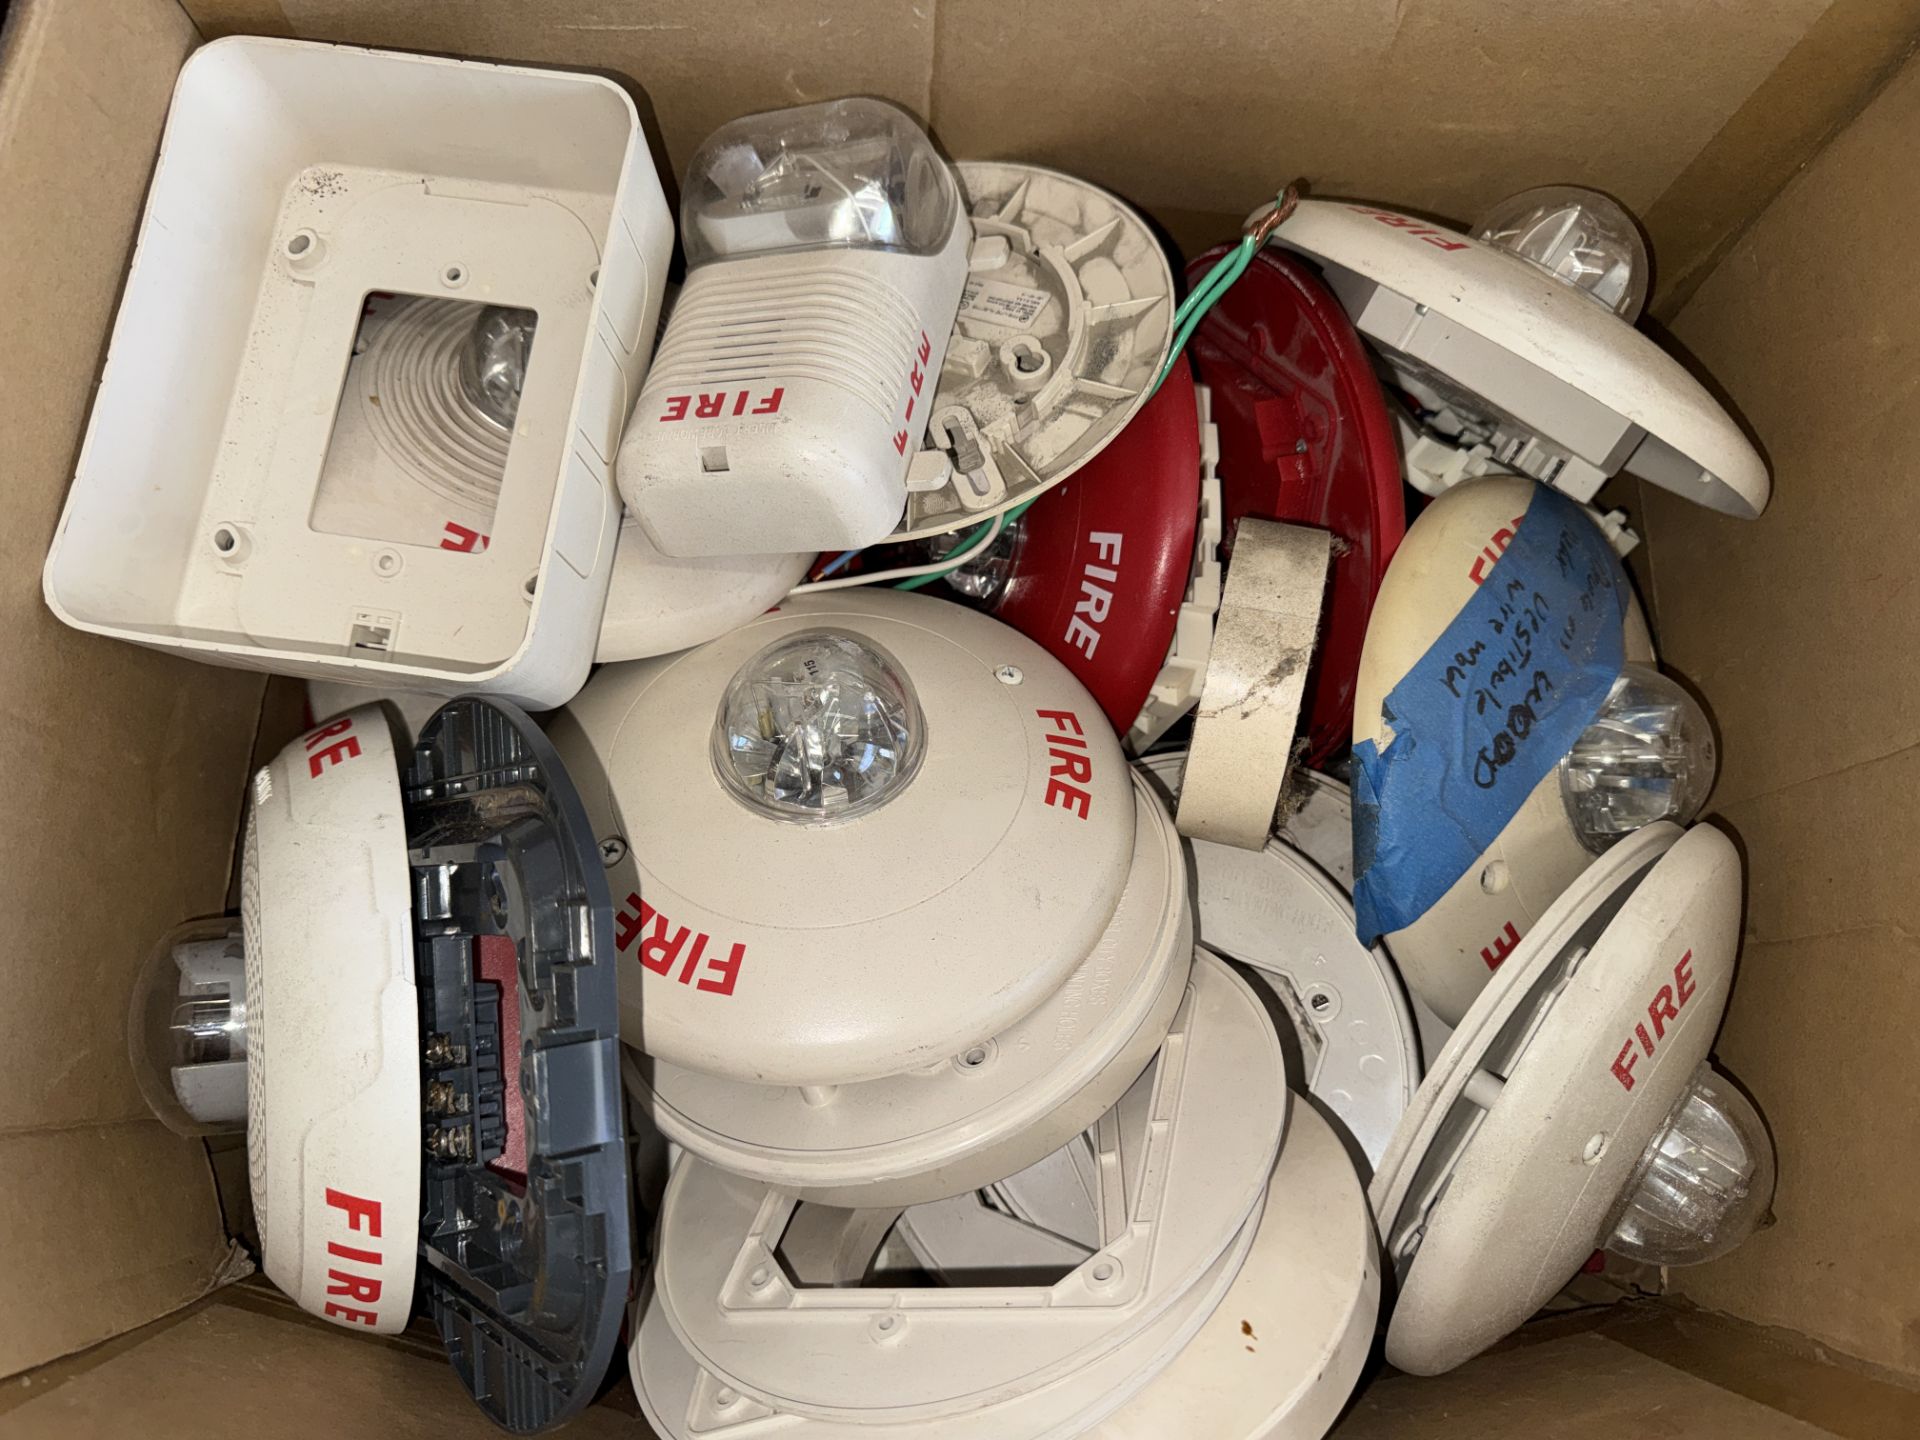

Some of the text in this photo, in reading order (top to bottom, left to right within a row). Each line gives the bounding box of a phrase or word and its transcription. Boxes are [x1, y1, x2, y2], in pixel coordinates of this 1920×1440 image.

[1344, 206, 1469, 251] FIRE
[659, 387, 785, 423] FIRE
[893, 330, 931, 456] FIRE
[1064, 532, 1122, 661] FIRE
[1036, 708, 1093, 821] FIRE
[616, 891, 747, 997] FIRE
[1611, 947, 1697, 1091] FIRE
[325, 1187, 384, 1327] FIRE
